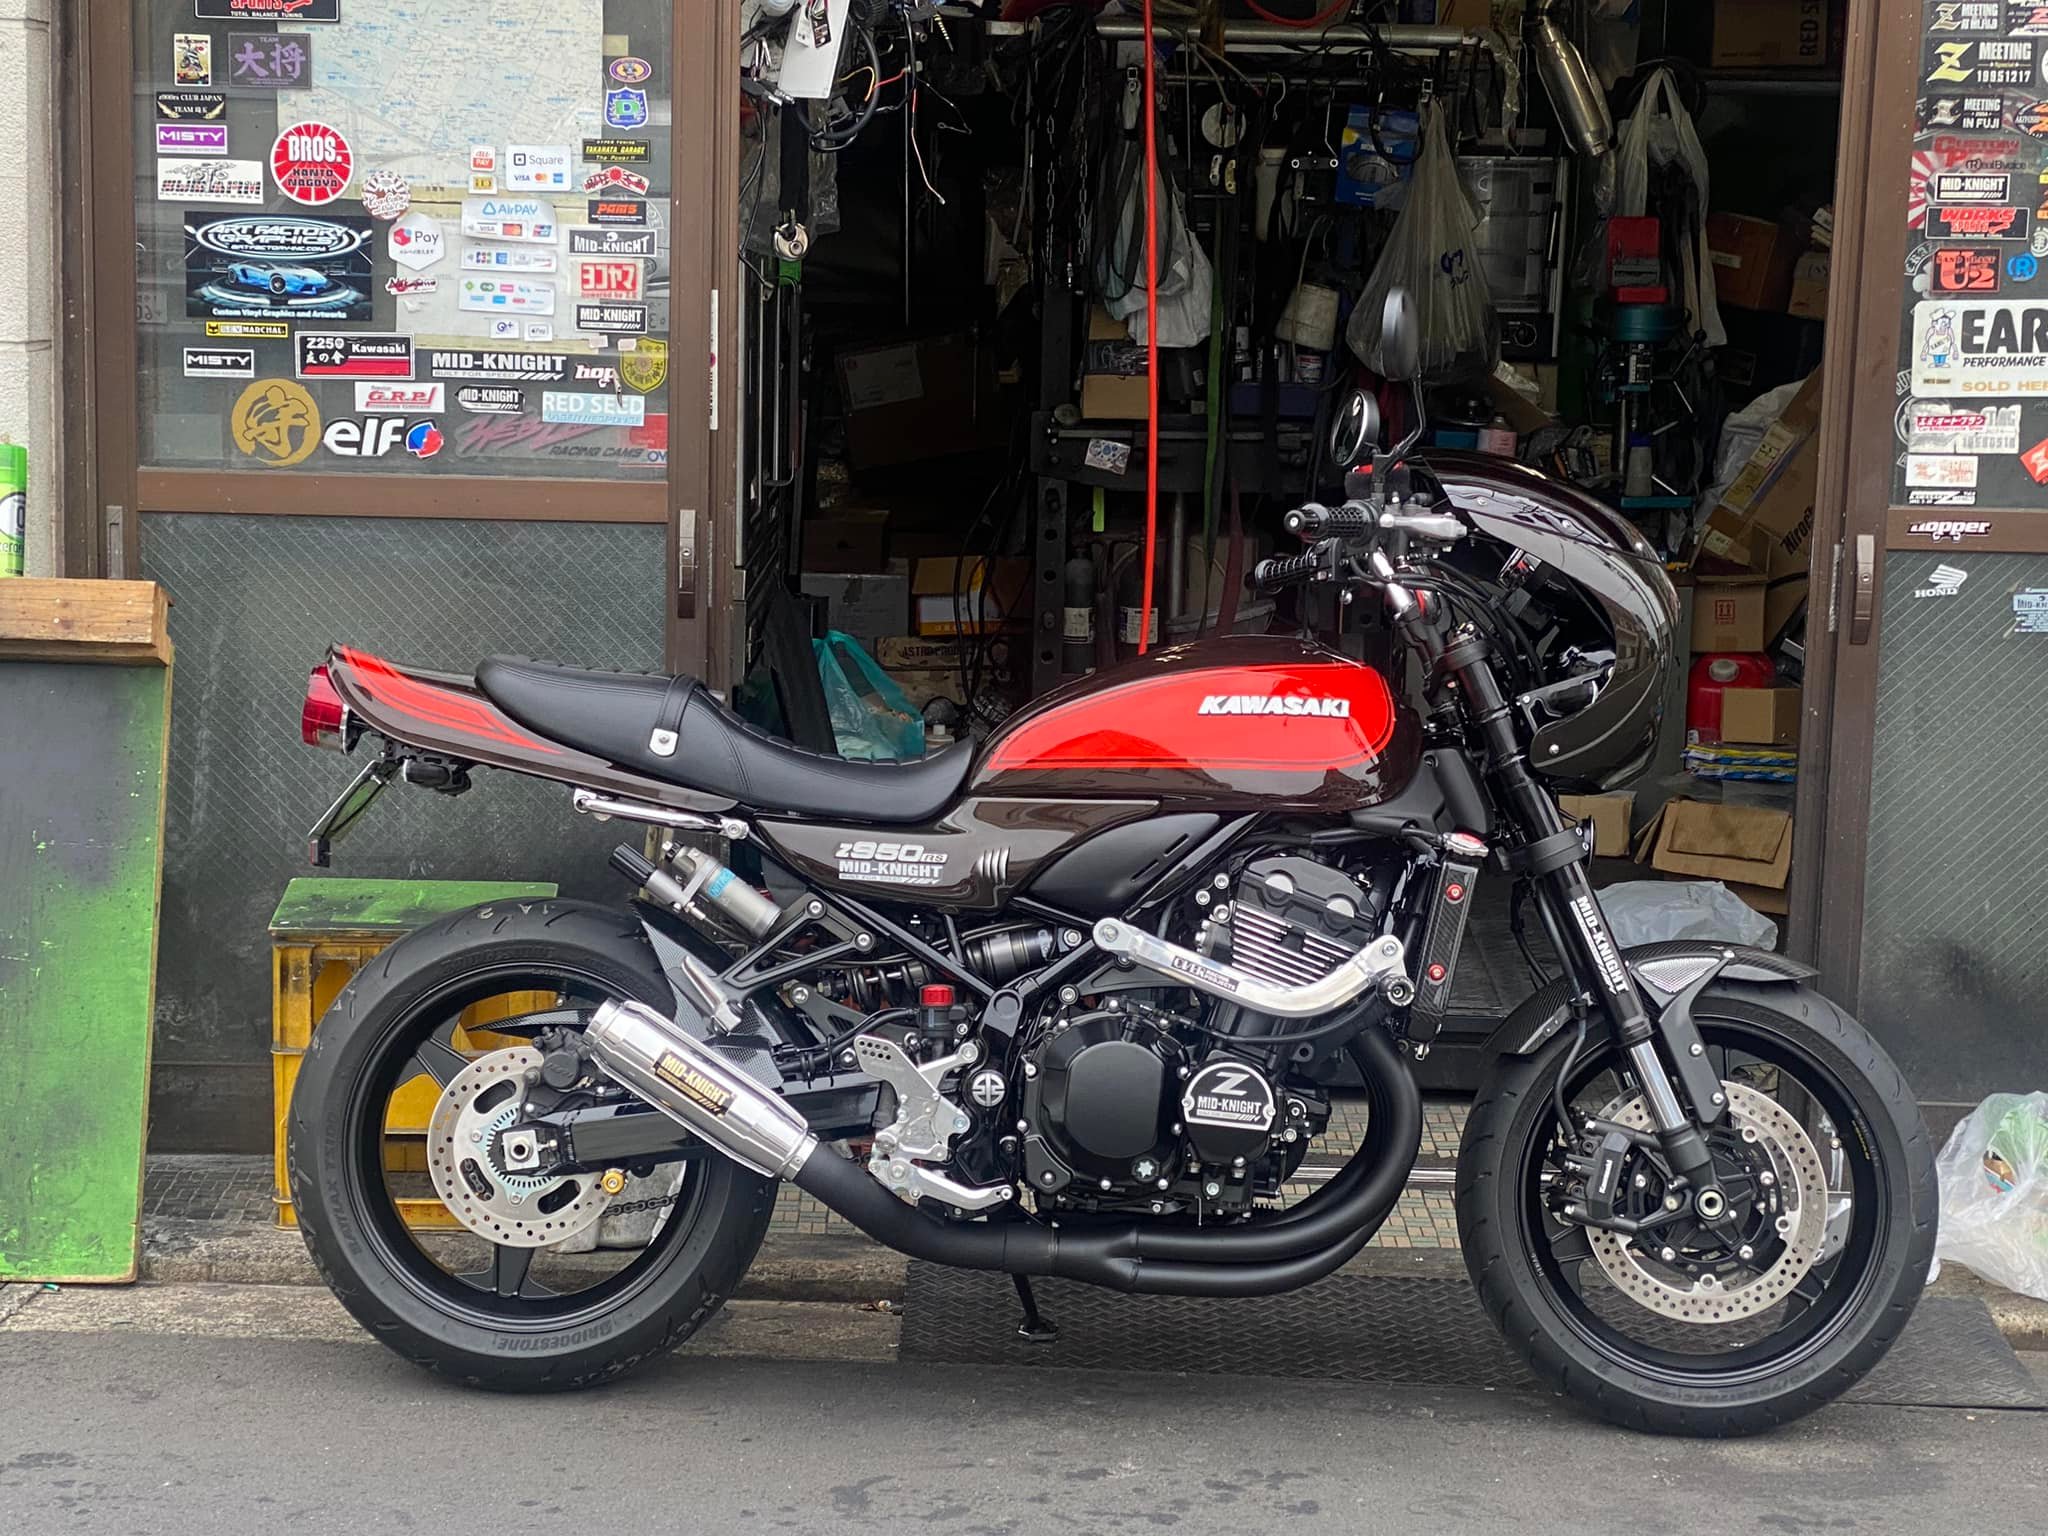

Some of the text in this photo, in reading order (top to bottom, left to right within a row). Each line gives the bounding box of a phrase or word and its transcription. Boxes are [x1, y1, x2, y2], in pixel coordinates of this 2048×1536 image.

[1961, 3, 1998, 16] MEETING
[1978, 42, 2032, 60] MEETING
[233, 41, 306, 79] 大将
[180, 94, 198, 102] CLUB
[1964, 98, 2001, 111] MEETING
[1962, 118, 2000, 128] IN FUJI
[160, 131, 223, 142] MISTY
[288, 136, 342, 162] BROS.
[529, 155, 564, 166] Square
[293, 168, 333, 177] KANTO
[288, 178, 337, 187] NAGOYA
[1940, 178, 2005, 191] MID-KNIGHT
[498, 203, 538, 215] AirPAY
[1940, 207, 2016, 222] WORKS
[208, 225, 348, 237] ART FACTORY
[1951, 221, 1989, 232] SPORTS
[218, 234, 334, 246] GRAPHICS
[415, 231, 439, 245] Pay
[574, 234, 649, 253] MID-KNIGHT
[212, 307, 242, 317] Custom
[243, 309, 262, 318] Vinyl
[263, 309, 295, 318] Graphics
[312, 310, 347, 318] Artworks
[580, 308, 642, 322] MID-KNIGHT
[306, 338, 405, 353] Z250 Kawasaki
[187, 355, 250, 365] MISTY
[432, 353, 566, 371] MID-KNIGHT
[1963, 356, 2046, 367] PERFORMANCE
[1962, 381, 2010, 391] SOLD
[460, 389, 519, 402] MID-KNIGHT
[543, 395, 643, 415] RED SEED
[323, 418, 405, 456] elf
[1199, 695, 1350, 718] KAWASAKI
[839, 860, 943, 877] MID-KNIGHT
[1576, 895, 1630, 993] MID-KNIGHT
[661, 1054, 730, 1106] MID-KNIGHT
[1211, 1071, 1250, 1096] Z
[1197, 1096, 1262, 1115] MID-KNIGHT
[497, 1319, 613, 1352] BRIDGESTONE
